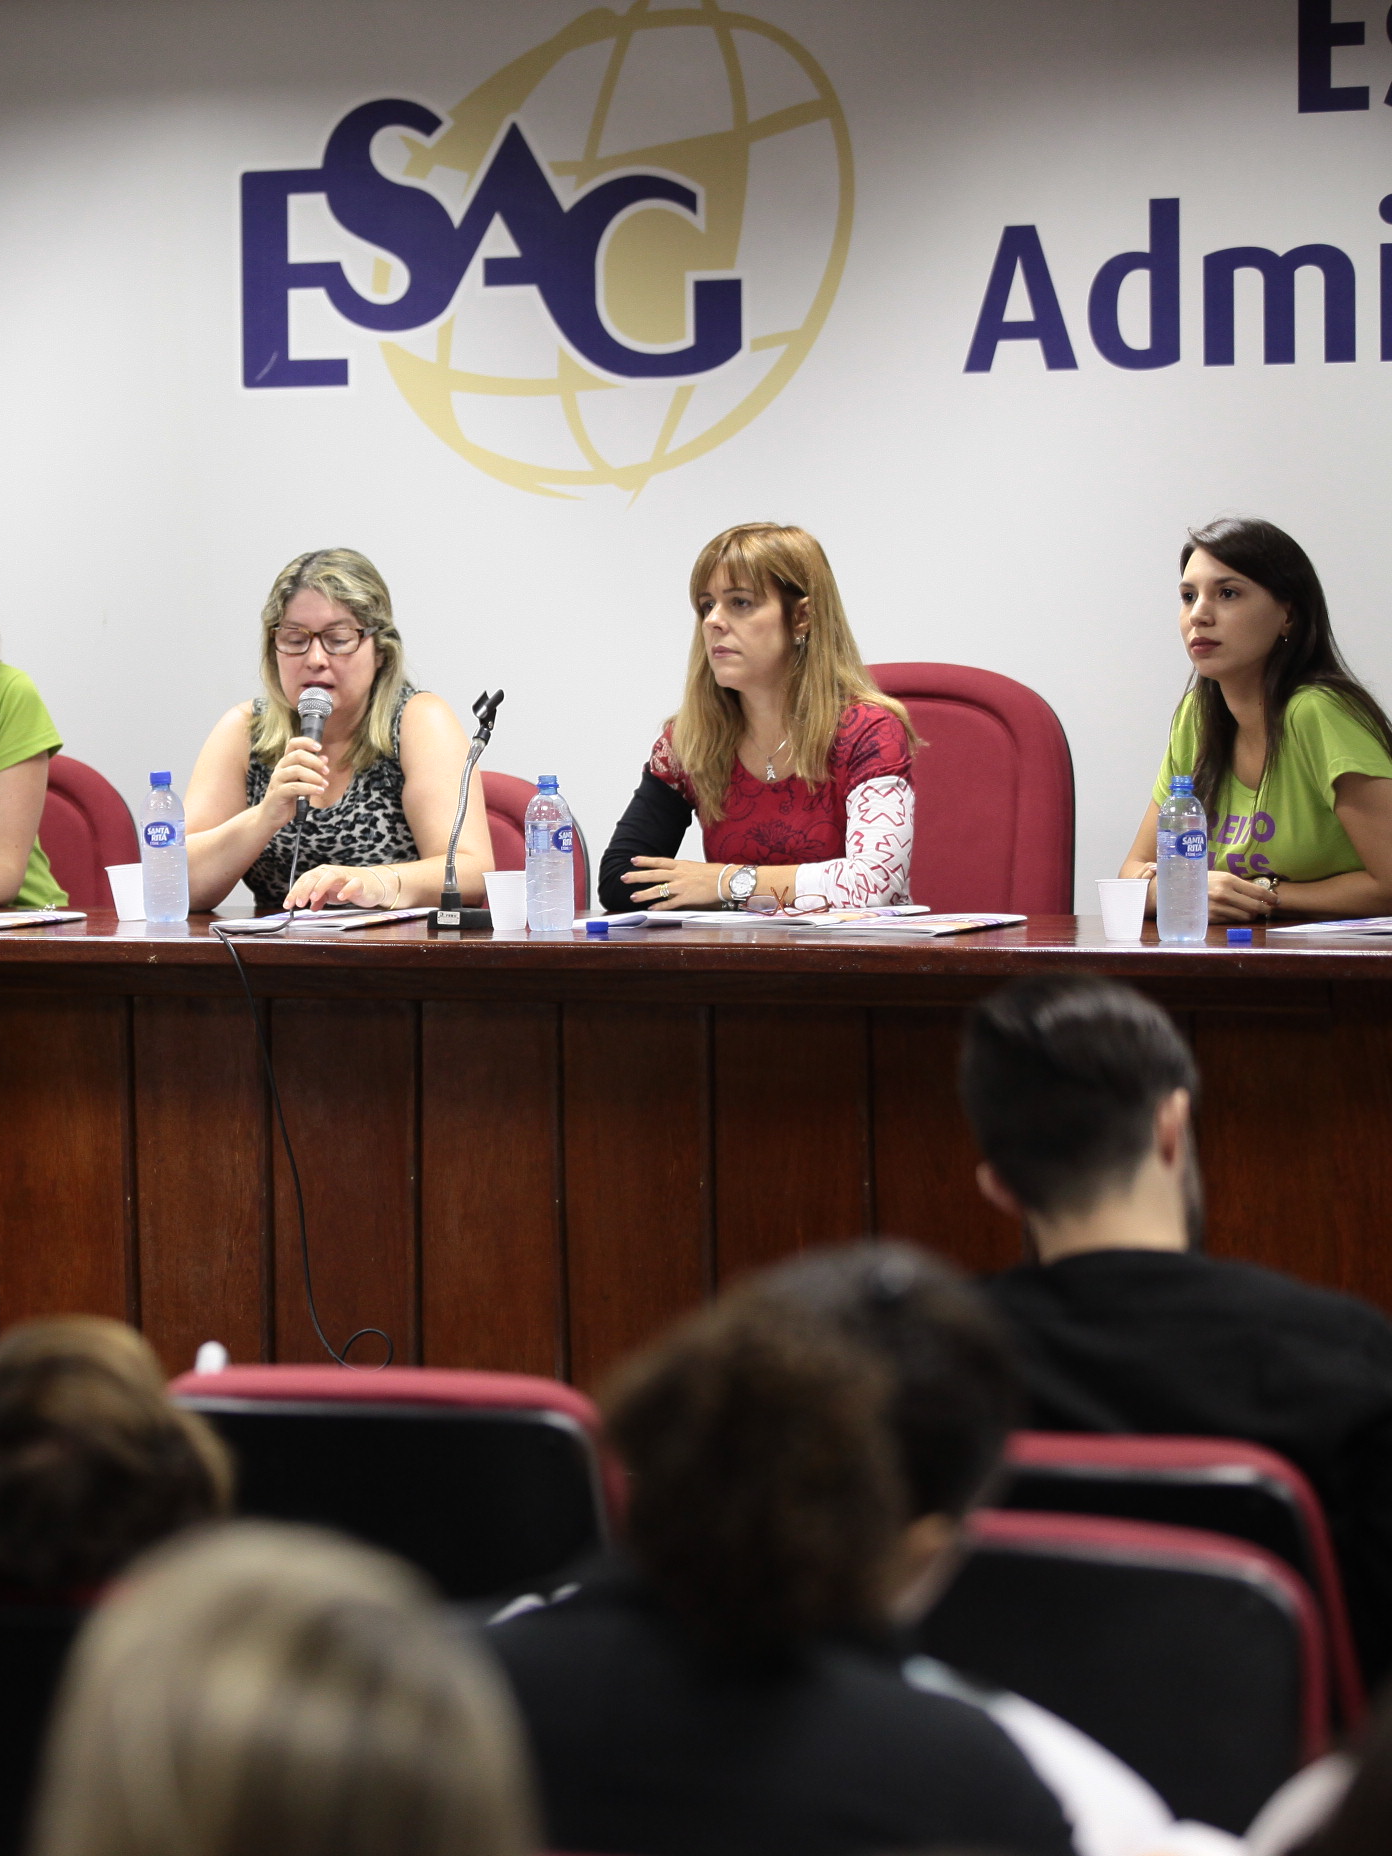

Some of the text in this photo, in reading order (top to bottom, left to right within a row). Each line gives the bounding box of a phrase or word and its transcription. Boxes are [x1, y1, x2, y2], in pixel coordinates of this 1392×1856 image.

[241, 98, 743, 388] ESAG
[147, 827, 170, 835] SANTA
[1182, 836, 1205, 845] SANTA
[1187, 844, 1203, 853] RITA
